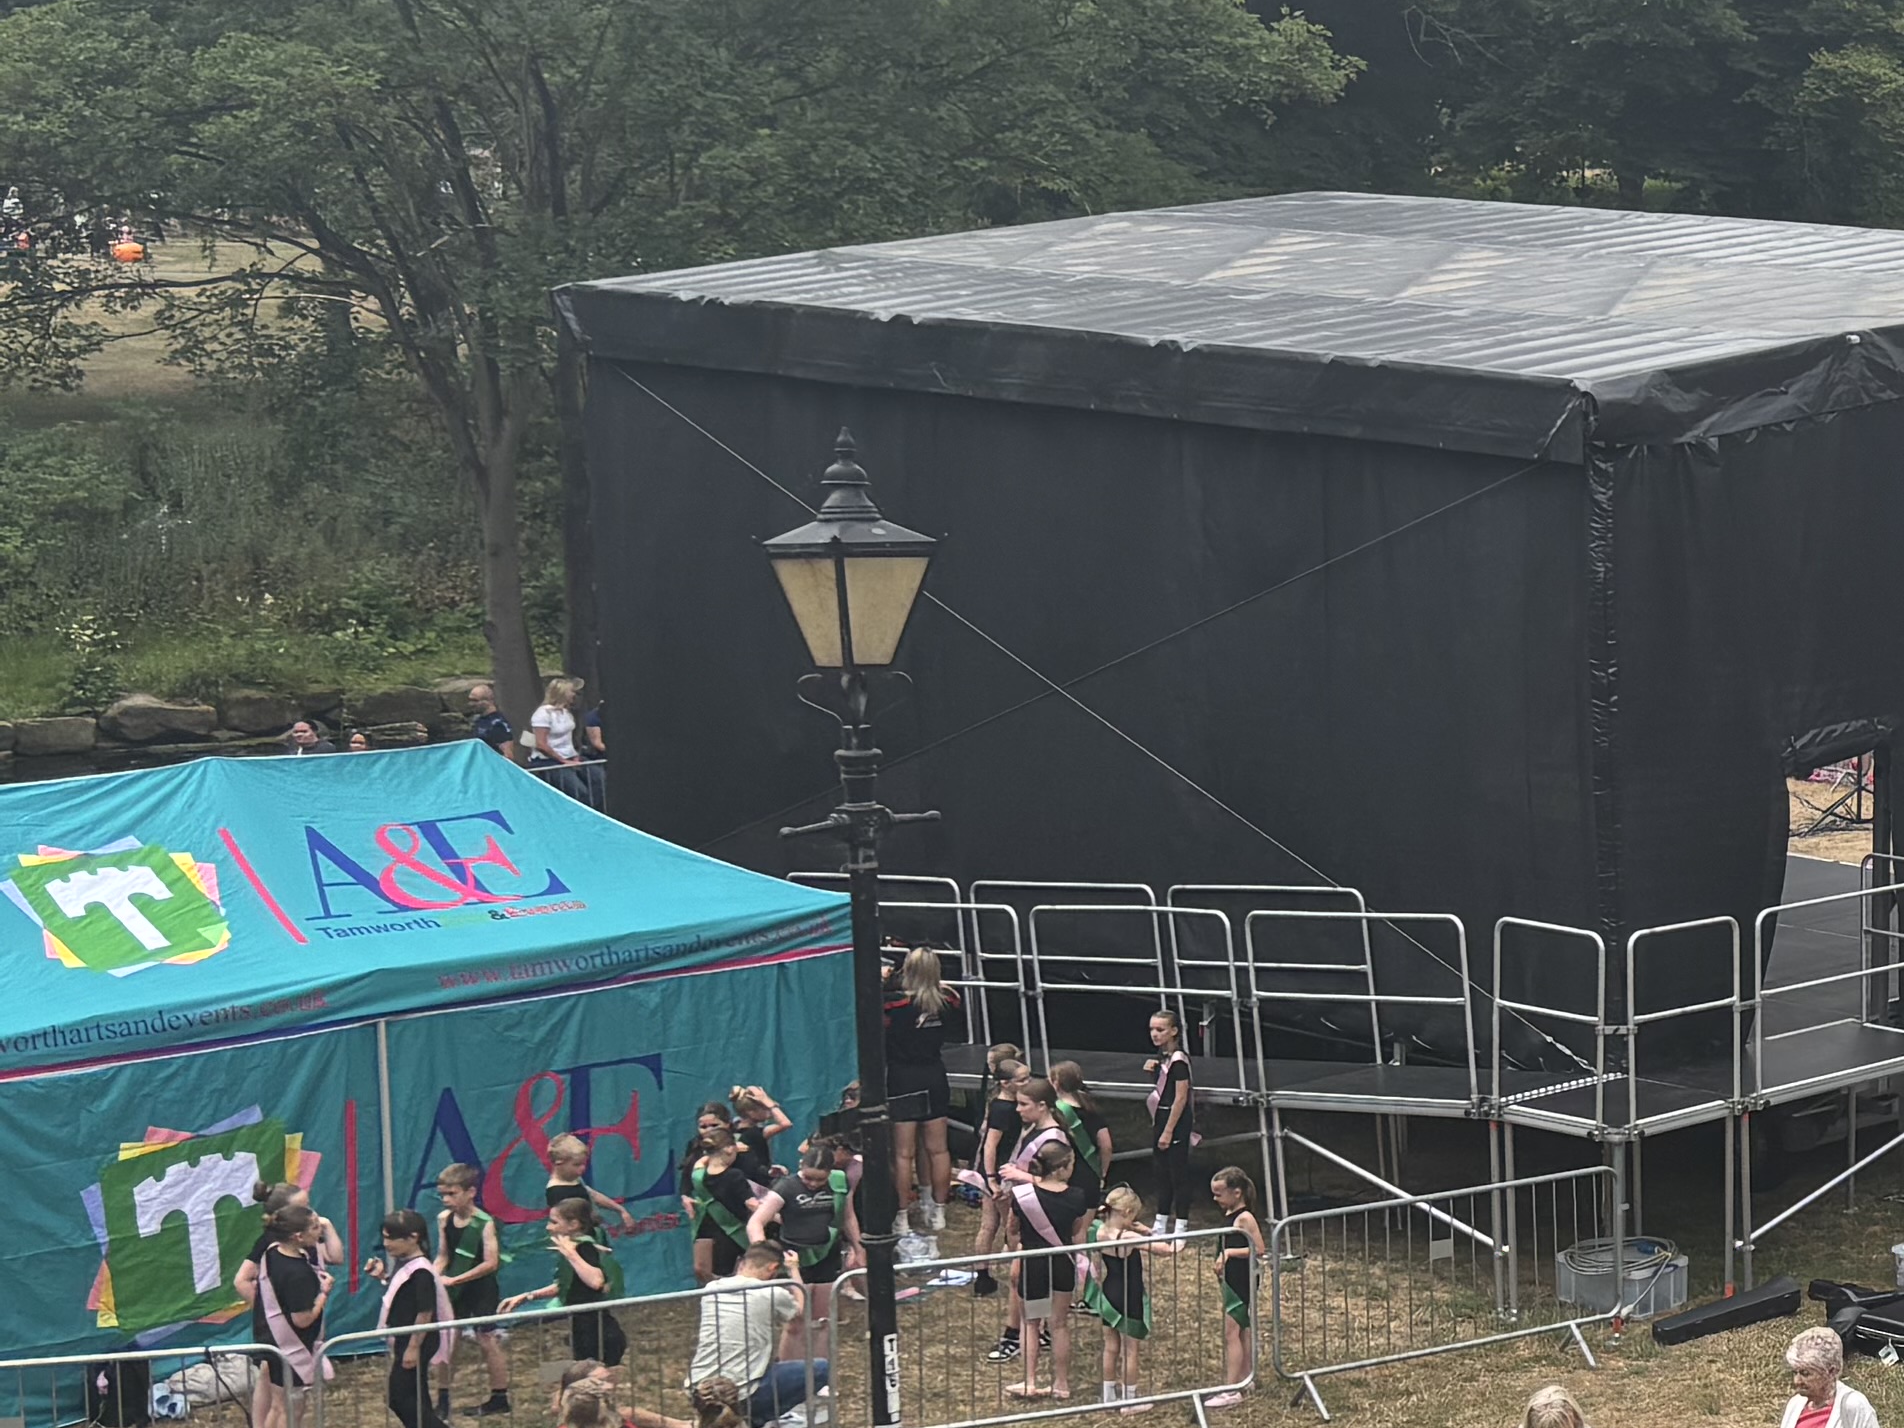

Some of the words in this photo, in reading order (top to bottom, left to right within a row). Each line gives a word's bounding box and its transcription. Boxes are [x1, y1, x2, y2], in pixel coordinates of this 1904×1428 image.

[305, 810, 572, 921] A&E
[315, 917, 442, 941] Tamworth
[407, 1053, 675, 1224] A&E
